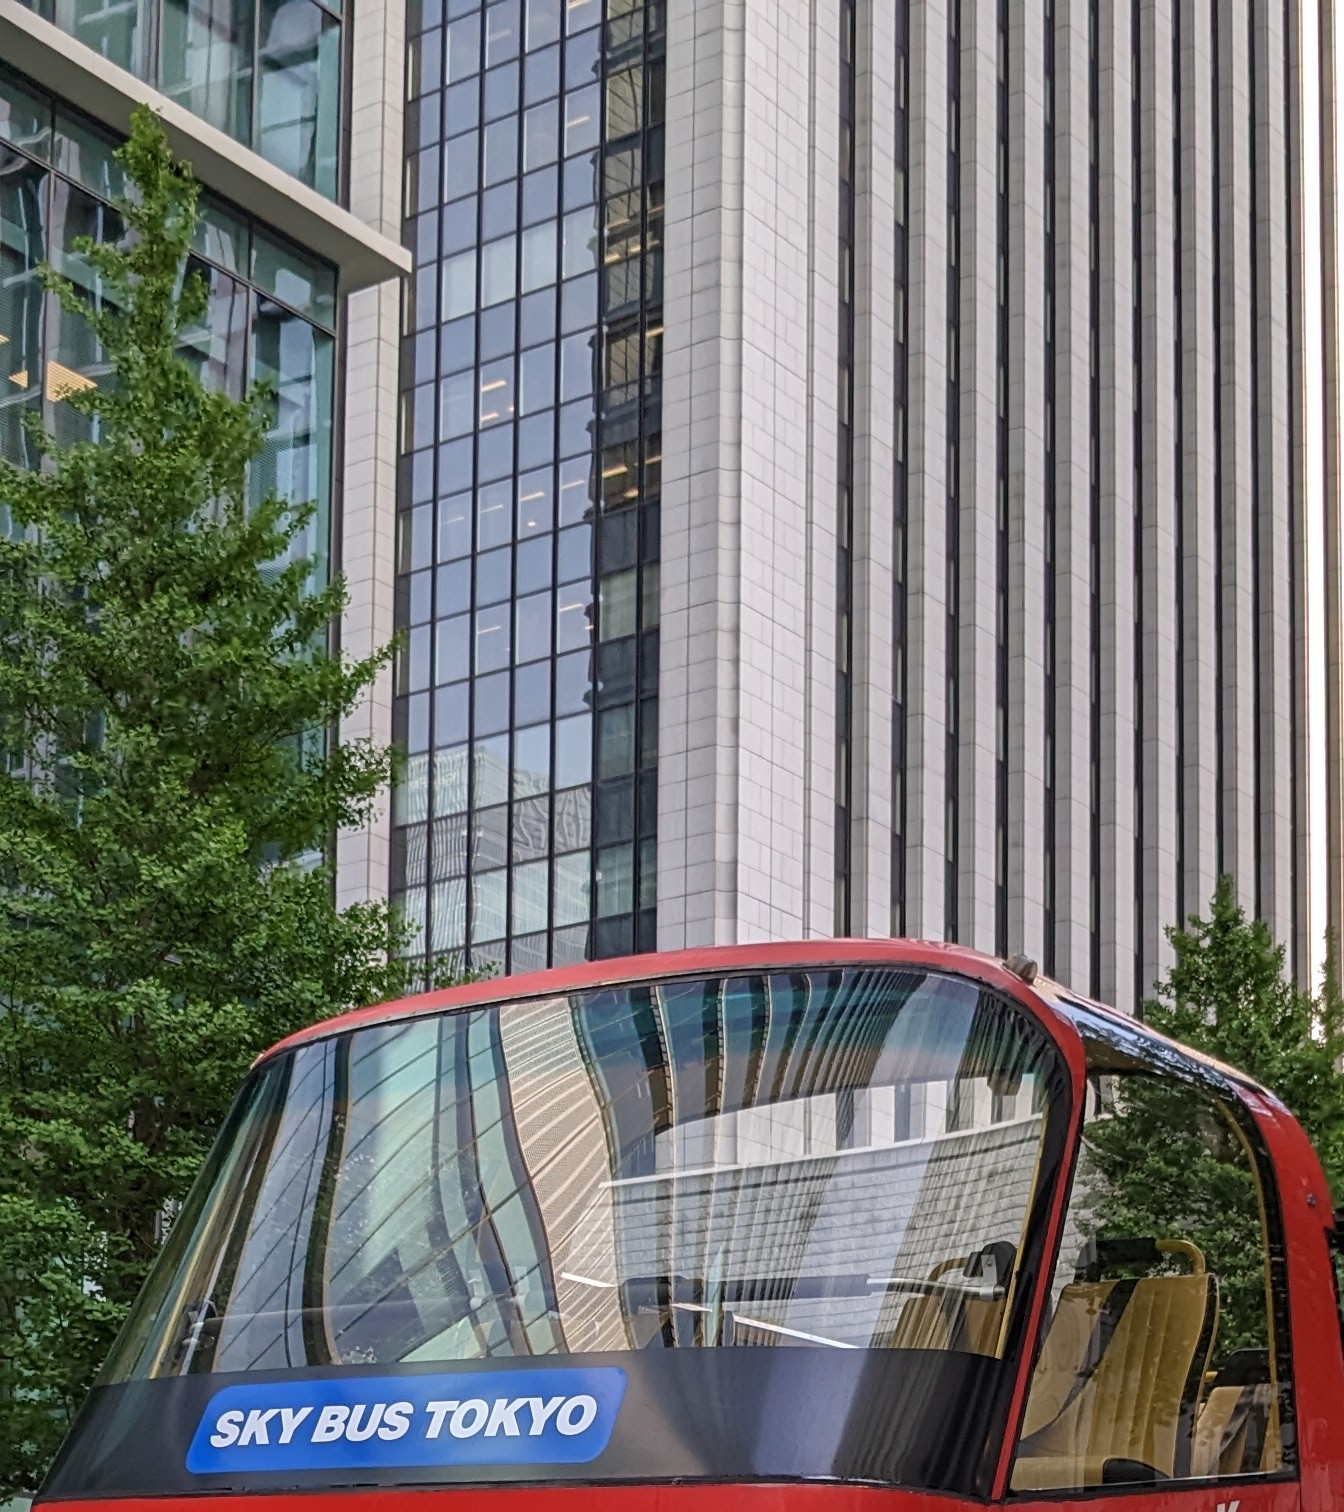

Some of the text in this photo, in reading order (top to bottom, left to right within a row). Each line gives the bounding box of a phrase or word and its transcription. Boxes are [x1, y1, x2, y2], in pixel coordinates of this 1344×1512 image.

[209, 1394, 598, 1448] SKY BUS TOKYO
